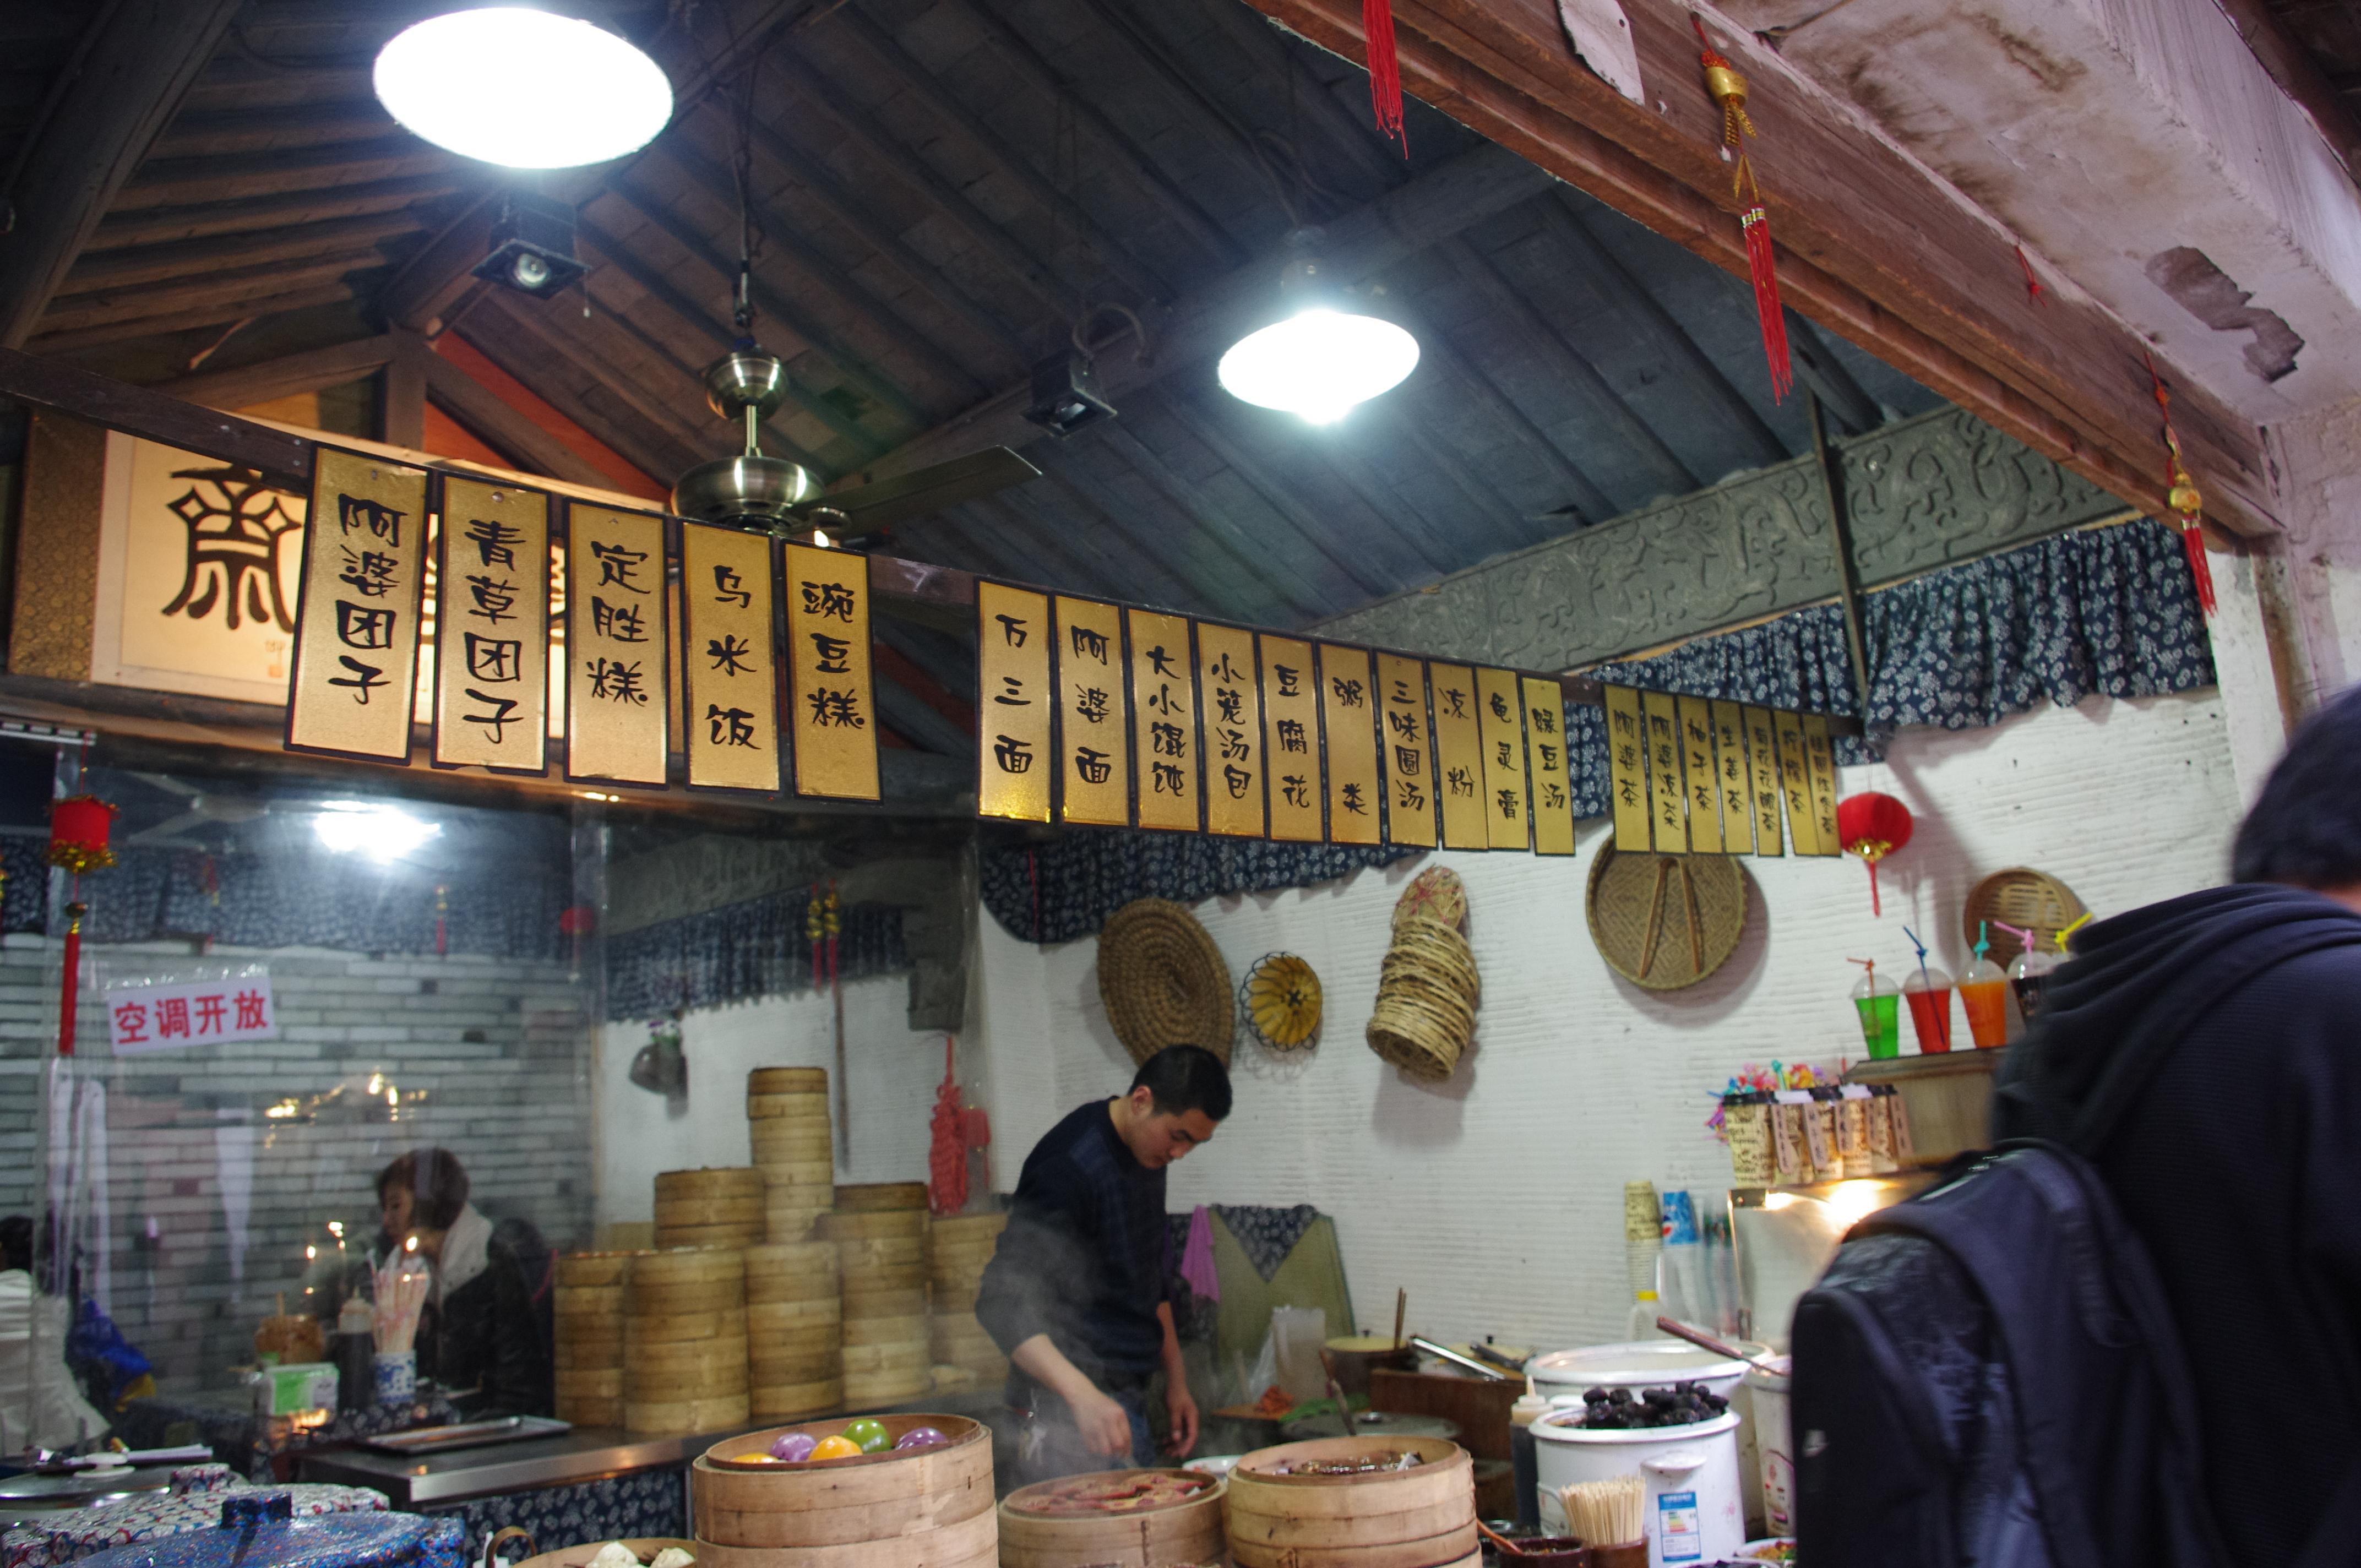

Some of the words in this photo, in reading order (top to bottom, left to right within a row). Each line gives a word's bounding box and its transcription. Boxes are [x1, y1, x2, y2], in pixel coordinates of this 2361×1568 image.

[328, 493, 409, 705] 阿婆团子
[462, 519, 526, 744] 青草团子
[585, 540, 651, 707] 定胜糕
[705, 565, 762, 750] 乌米饭
[801, 581, 866, 729] 豌豆糕
[994, 614, 1033, 774] 万三面
[1070, 625, 1112, 784] 阿婆面
[1146, 645, 1185, 797] 大小馄饨
[1211, 653, 1252, 799] 小笼汤包
[1274, 664, 1310, 808] 豆腐花
[1332, 677, 1369, 816] 粥类
[1389, 680, 1425, 812] 三味圆汤
[1438, 687, 1476, 797] 凉粉
[1490, 692, 1519, 820] 龟灵膏
[1613, 709, 1641, 808] 阿婆茶
[1651, 714, 1680, 831] 阿婆凉茶
[115, 989, 268, 1045] 空调开放
